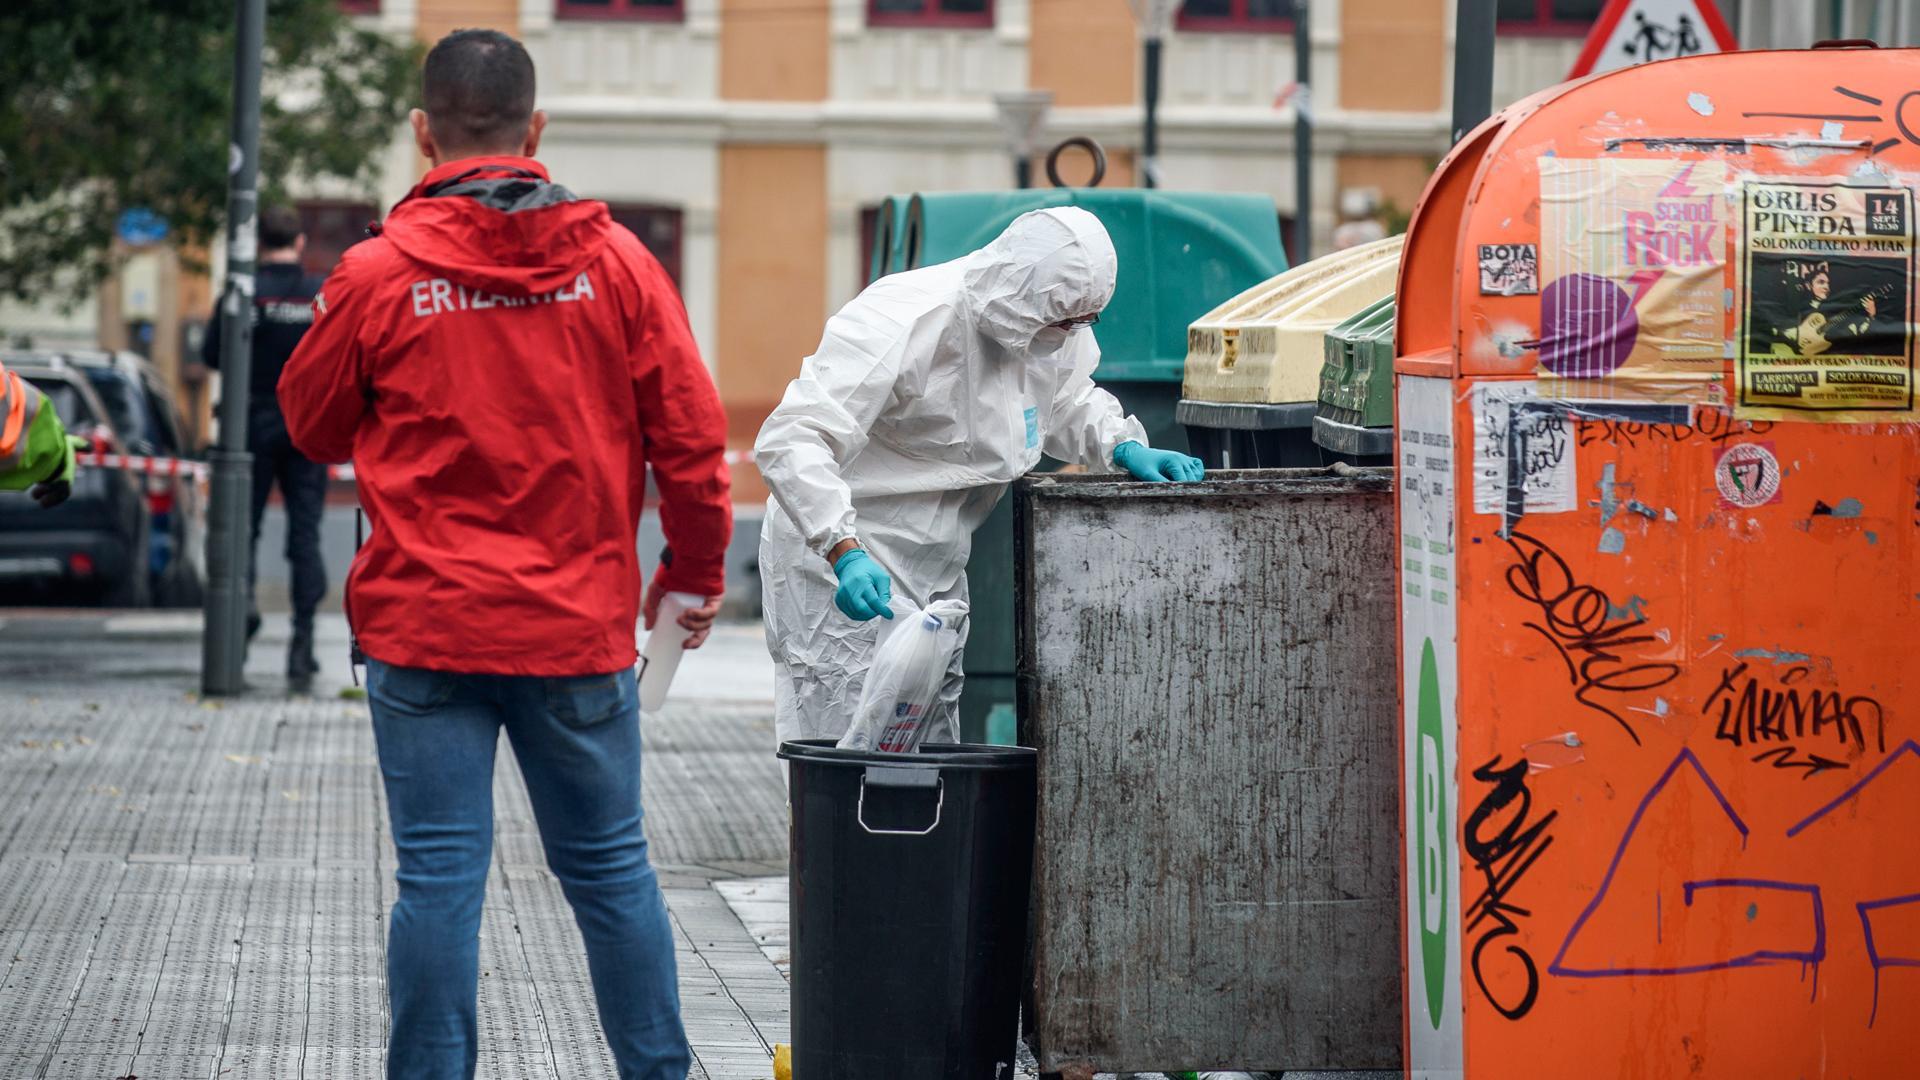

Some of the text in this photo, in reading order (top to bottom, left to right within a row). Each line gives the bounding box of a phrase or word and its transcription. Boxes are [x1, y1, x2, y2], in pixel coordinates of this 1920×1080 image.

[1754, 190, 1837, 212] ORLIS
[1872, 199, 1899, 214] 14
[1754, 212, 1856, 236] PINEDA
[1625, 210, 1717, 267] ROCK
[1752, 237, 1905, 252] SOLOKOETXEKO JAIAK
[1482, 245, 1536, 260] BOTA
[1755, 372, 1815, 384] LARRINAGA
[1755, 383, 1796, 393] KALEAN
